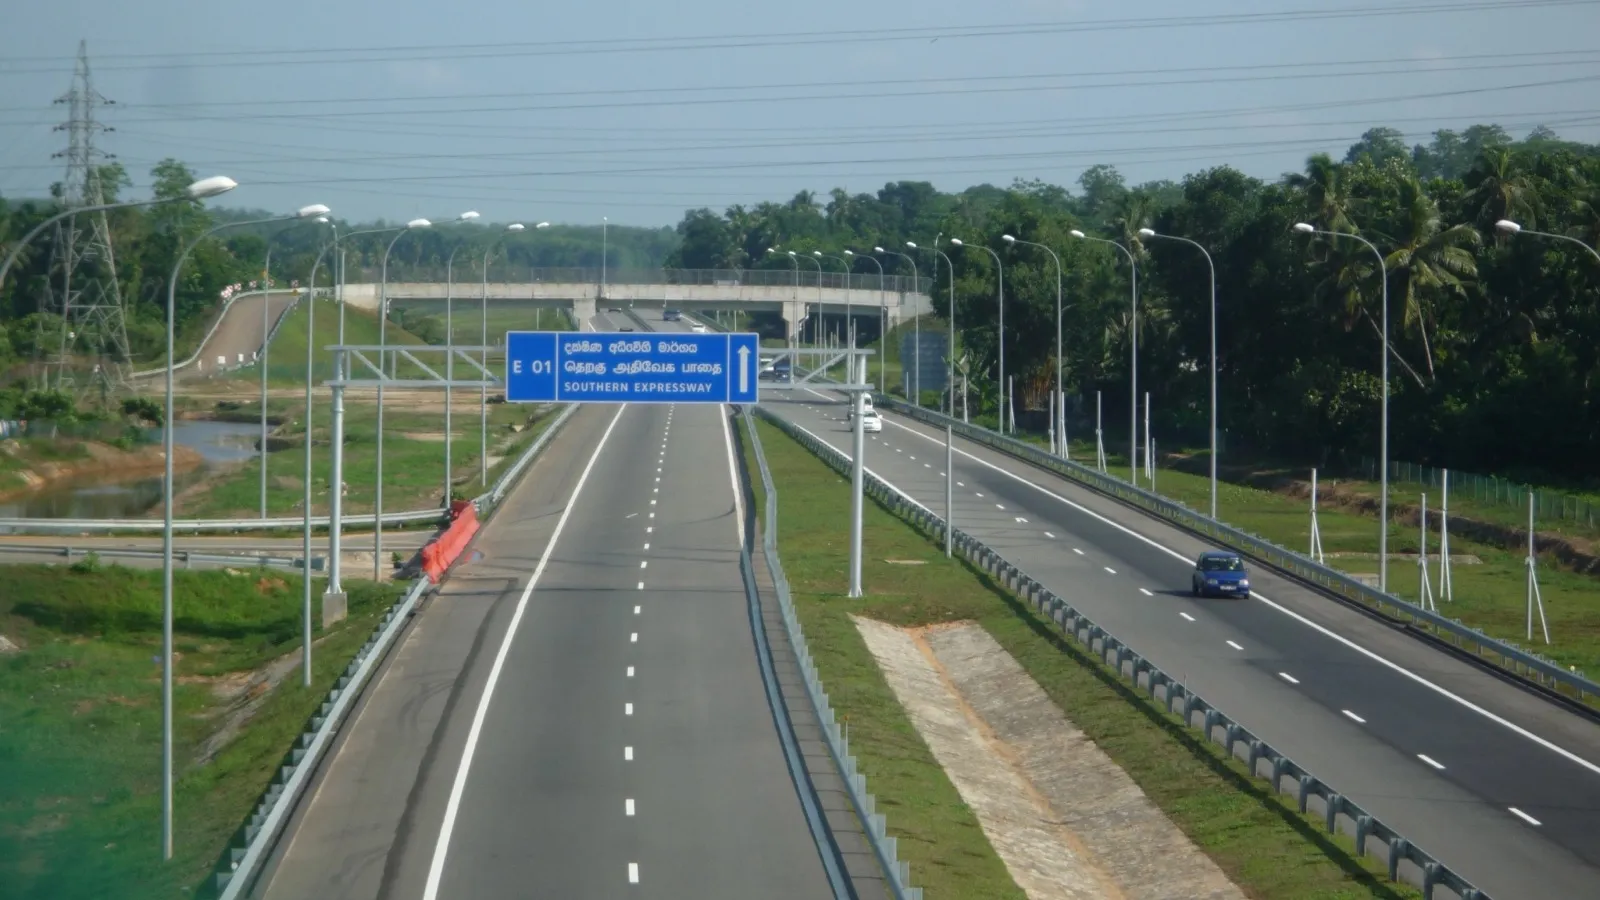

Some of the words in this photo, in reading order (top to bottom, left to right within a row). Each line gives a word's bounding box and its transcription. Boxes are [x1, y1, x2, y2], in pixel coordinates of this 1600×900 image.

[513, 360, 523, 374] E
[532, 360, 552, 374] 01
[612, 359, 676, 375] அதிவேக
[682, 362, 722, 375] பாதை
[564, 382, 629, 392] SOUTHERN
[634, 382, 711, 392] EXPRESSWAY
